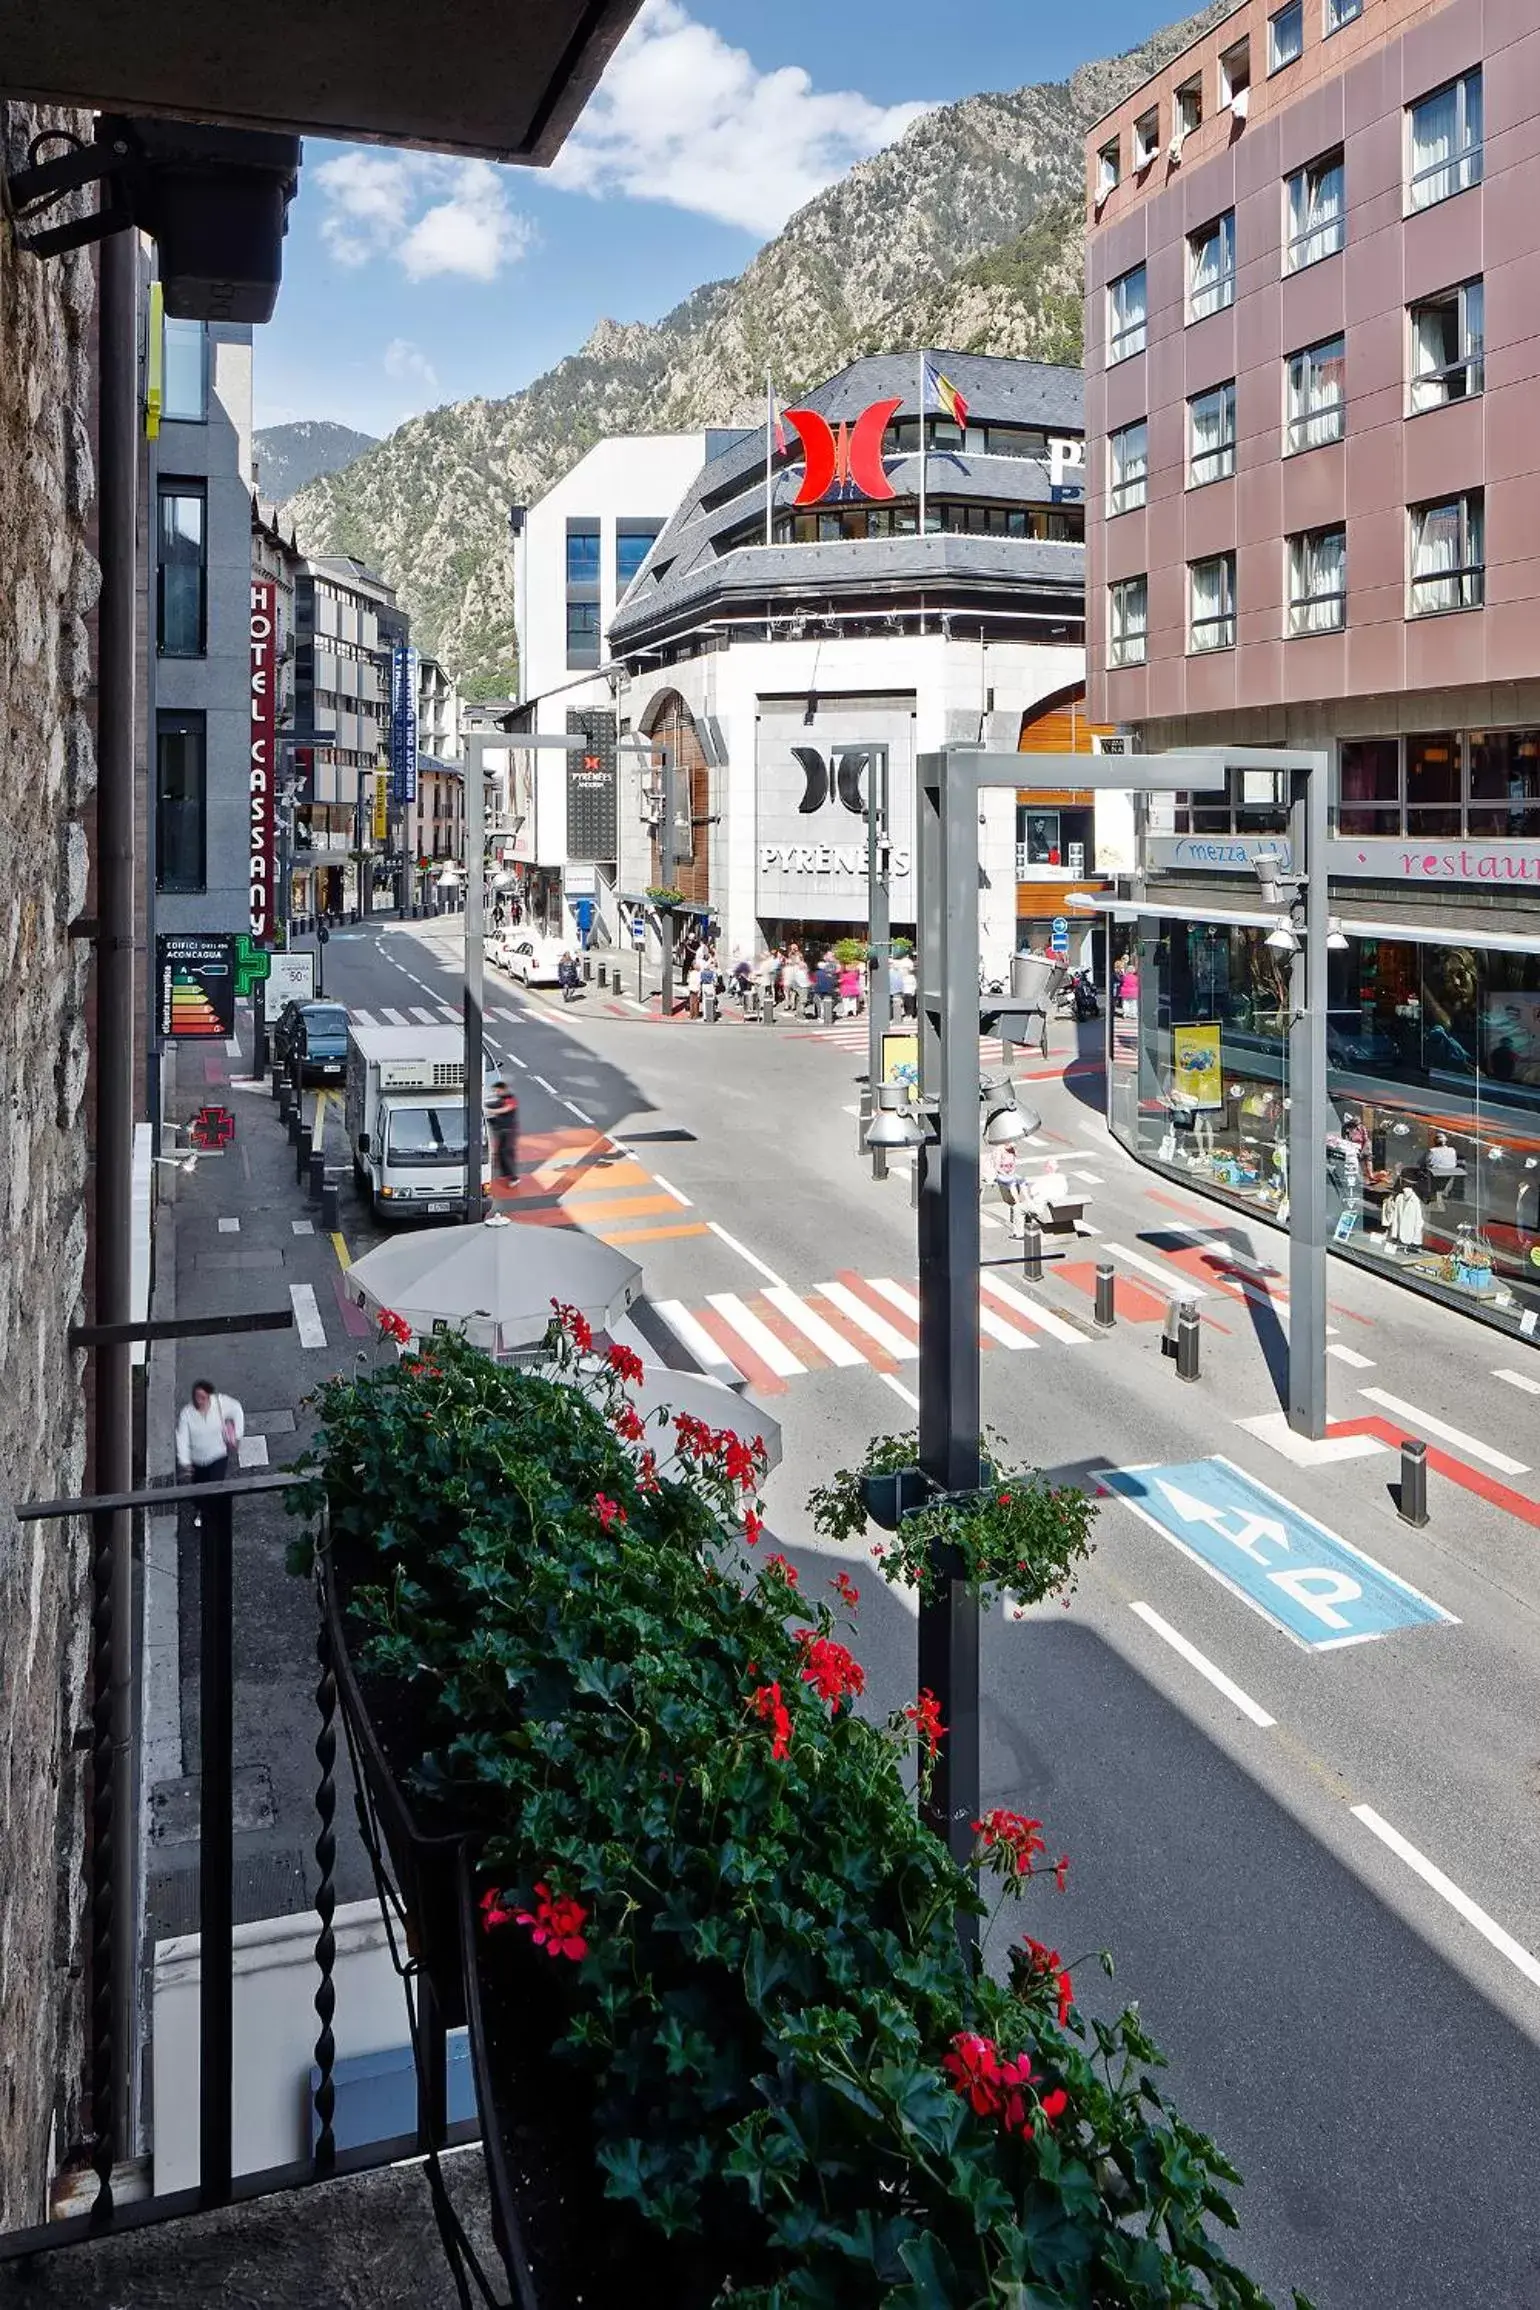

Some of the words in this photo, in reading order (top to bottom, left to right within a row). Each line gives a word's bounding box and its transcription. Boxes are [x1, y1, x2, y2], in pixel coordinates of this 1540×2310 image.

[250, 586, 271, 722] HOTEL
[249, 739, 267, 936] CASSANY
[166, 951, 222, 959] ACONCAGUA
